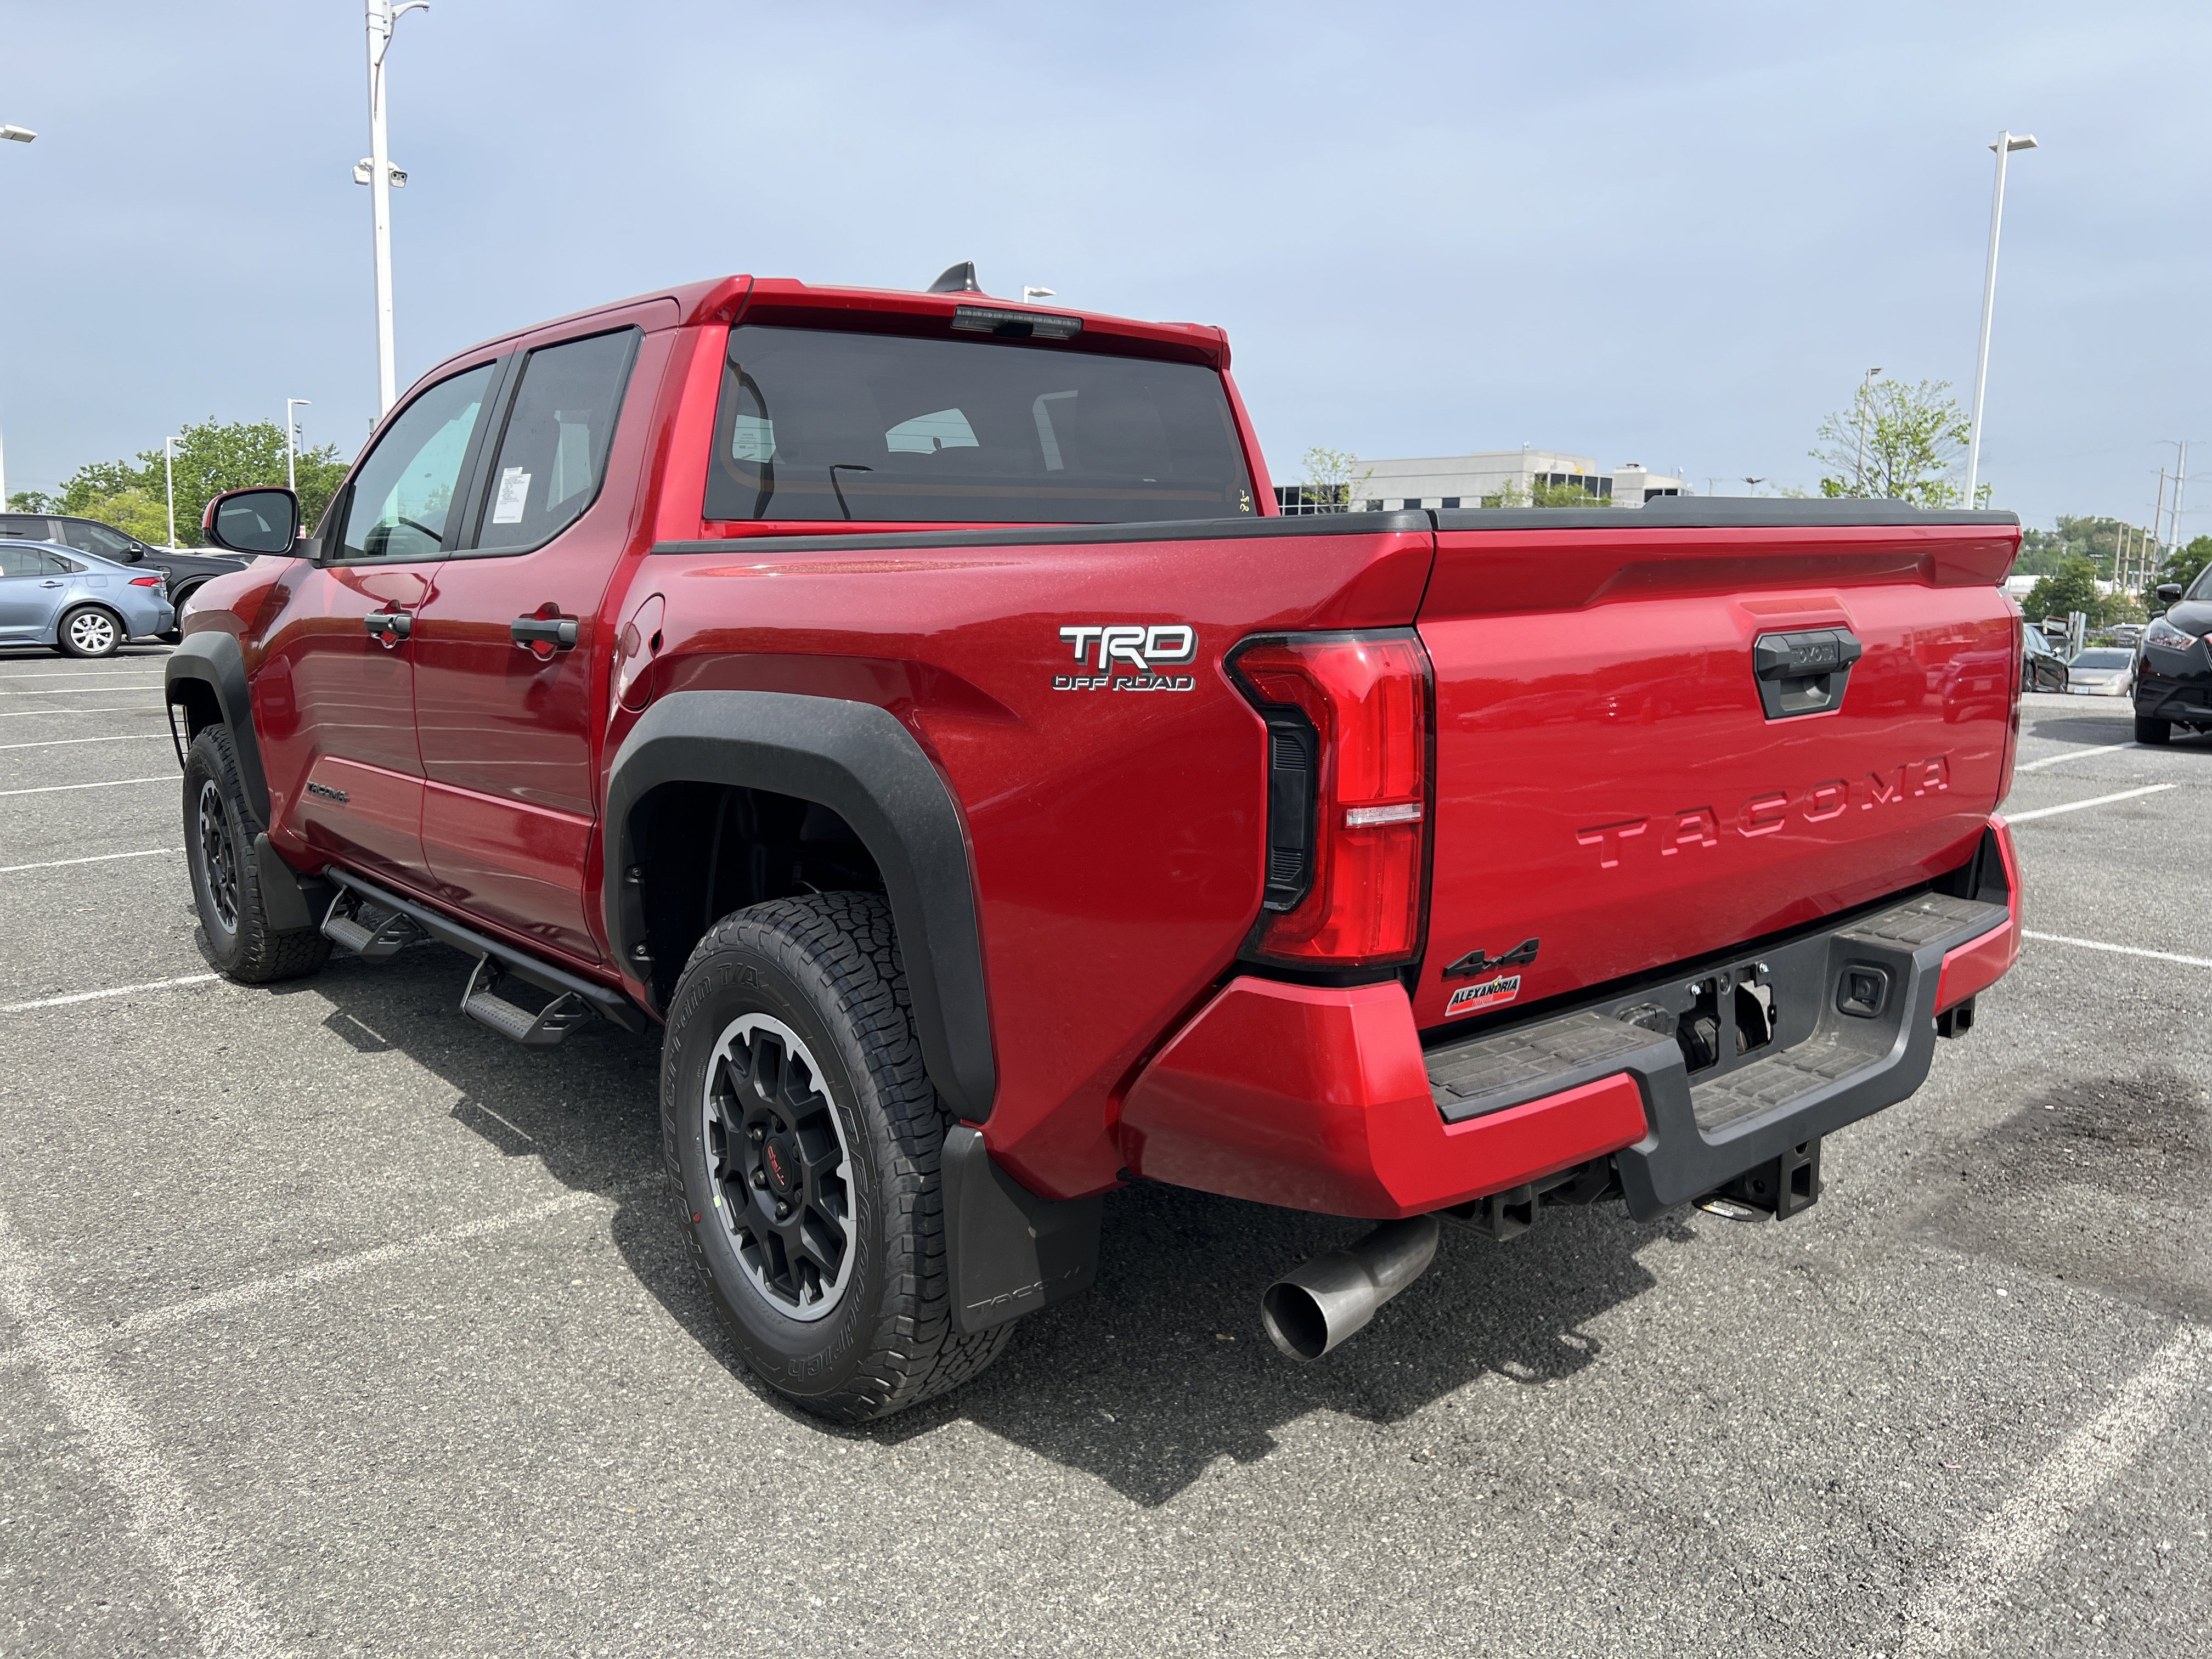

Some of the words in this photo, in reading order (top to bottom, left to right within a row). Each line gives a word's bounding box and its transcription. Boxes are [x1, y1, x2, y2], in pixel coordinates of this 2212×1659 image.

[1059, 624, 1198, 675] TRD
[1791, 645, 1836, 664] TOYOTA
[1052, 675, 1108, 691] OFF
[1113, 675, 1196, 691] ROAD
[307, 781, 348, 803] TACOMA
[1576, 755, 1950, 868] TACOMA
[717, 962, 759, 990] T/A
[1451, 978, 1519, 1005] ALEXANDRIA
[768, 1145, 785, 1186] TRD
